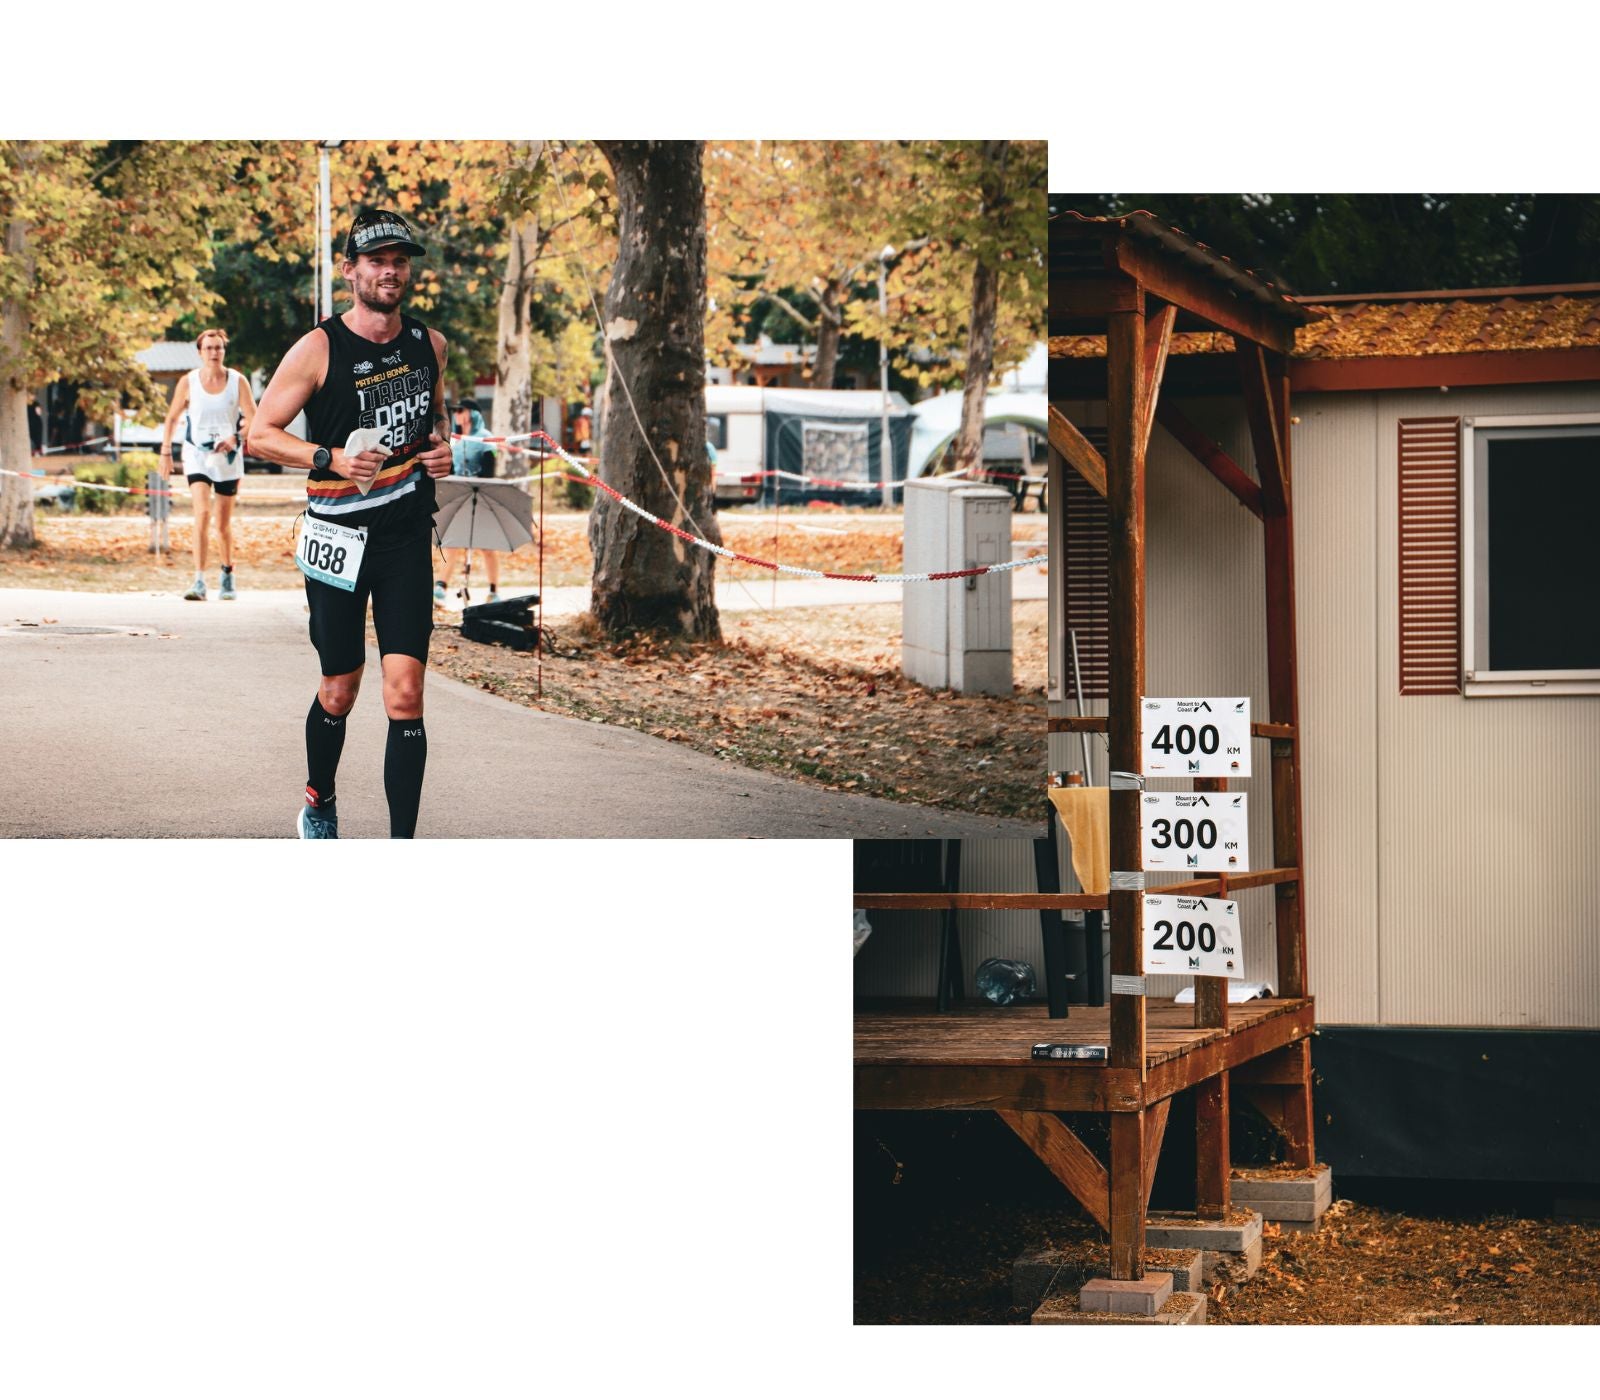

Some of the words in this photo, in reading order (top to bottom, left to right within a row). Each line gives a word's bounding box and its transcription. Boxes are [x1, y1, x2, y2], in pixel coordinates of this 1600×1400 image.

[386, 364, 410, 378] BONNE
[303, 534, 347, 575] 1038
[1151, 724, 1220, 755] 400
[1227, 747, 1241, 755] KM
[1151, 818, 1218, 850] 300
[1224, 842, 1238, 850] KM
[1152, 920, 1216, 953] 200
[1222, 946, 1235, 955] KM
